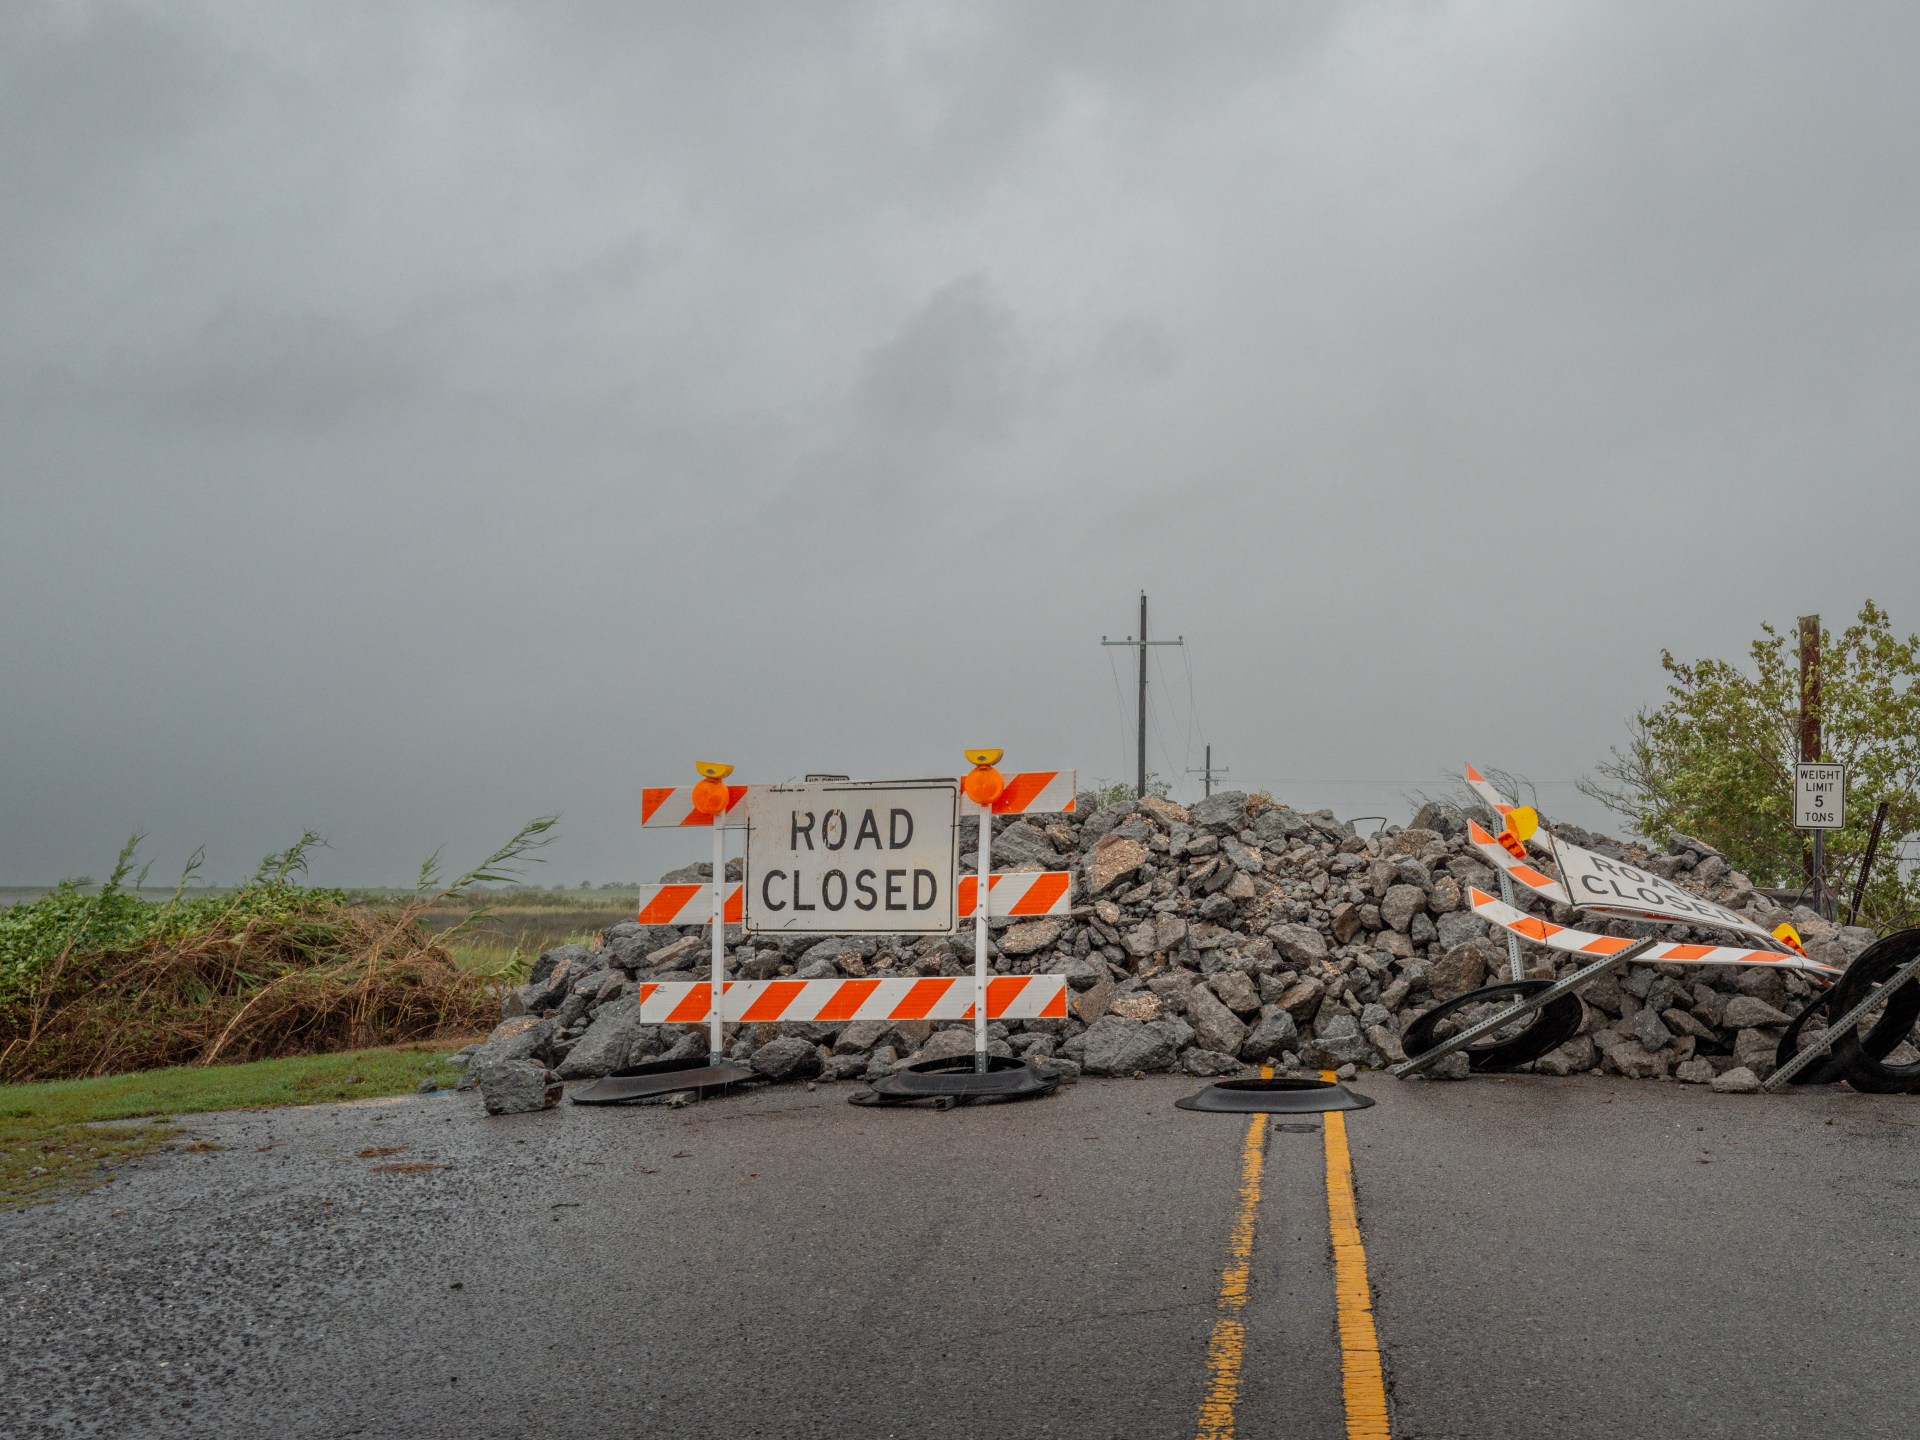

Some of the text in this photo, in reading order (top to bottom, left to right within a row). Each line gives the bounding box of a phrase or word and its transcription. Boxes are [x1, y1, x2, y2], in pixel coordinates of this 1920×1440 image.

[1800, 770, 1840, 780] WEIGHT
[1806, 782, 1834, 792] LIMIT
[1815, 795, 1823, 808] 5
[1805, 812, 1834, 822] TONS
[791, 808, 914, 851] ROAD
[762, 868, 938, 911] CLOSED
[1581, 874, 1744, 924] CLOSED
